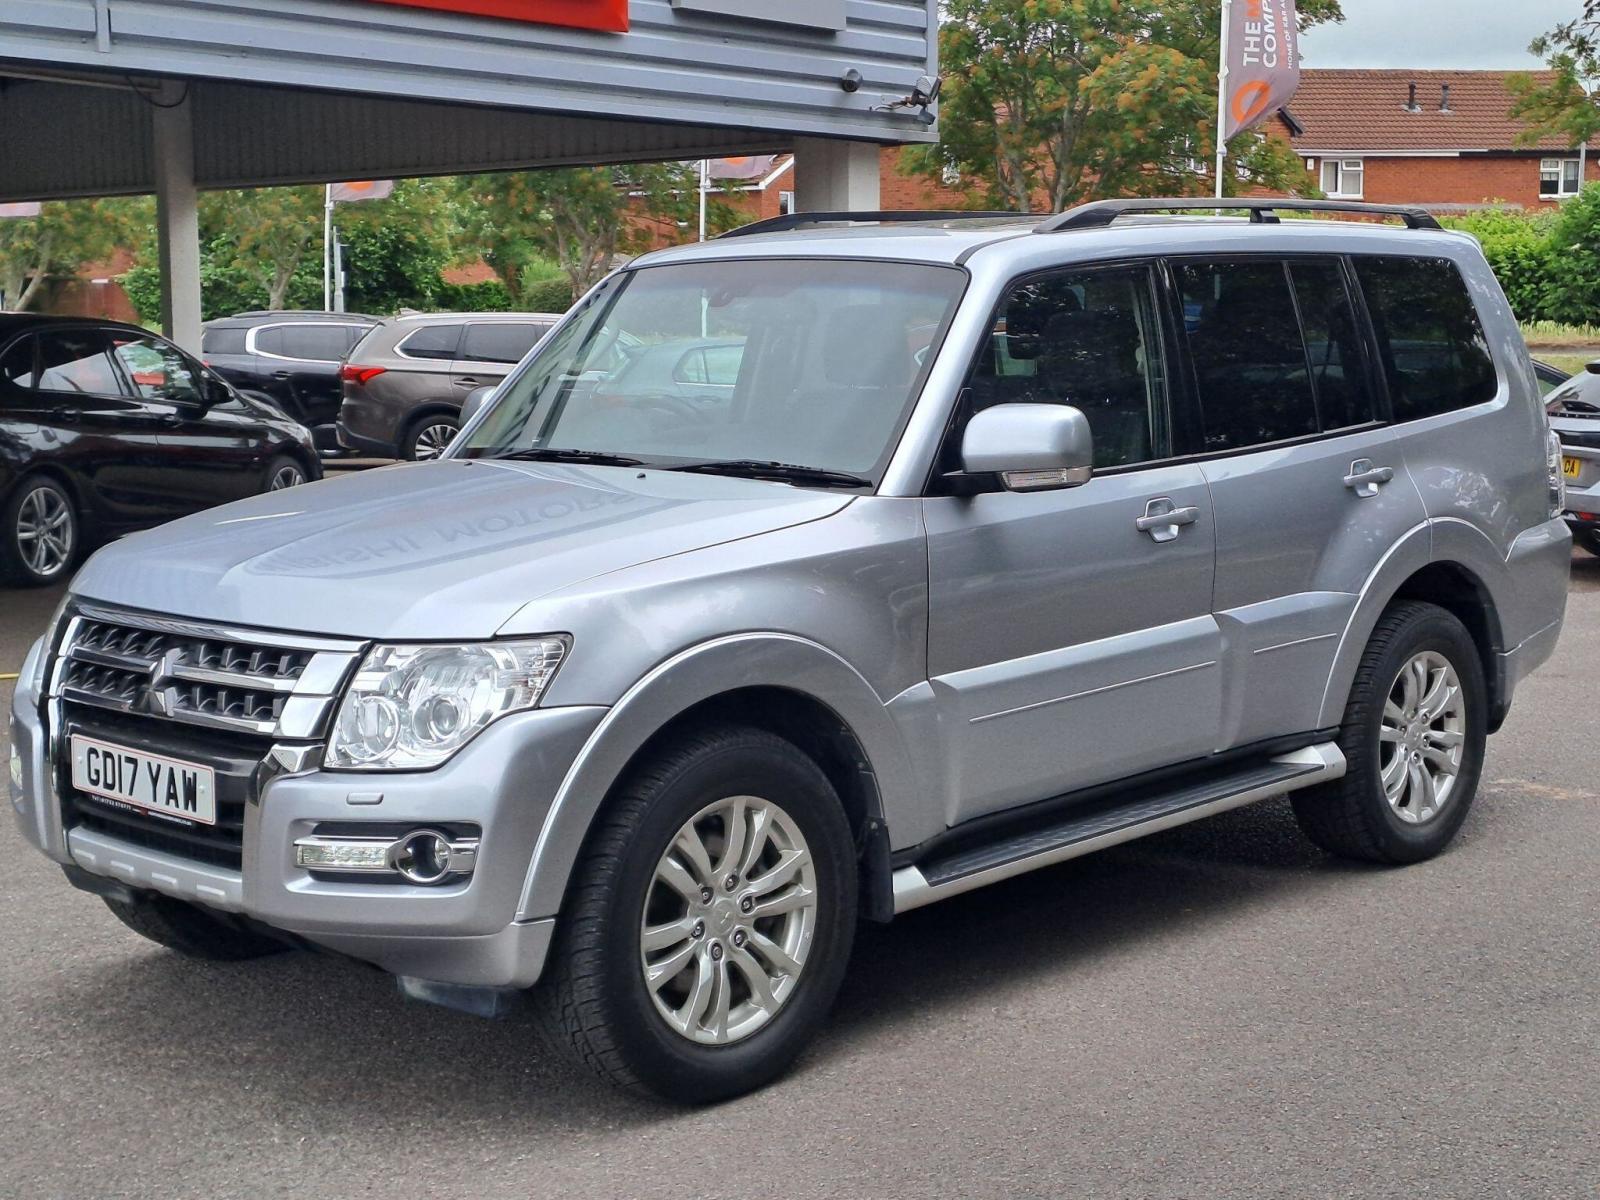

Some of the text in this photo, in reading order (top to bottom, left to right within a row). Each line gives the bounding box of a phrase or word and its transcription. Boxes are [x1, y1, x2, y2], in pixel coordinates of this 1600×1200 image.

[1243, 22, 1261, 67] THE
[1262, 0, 1277, 68] COMP
[86, 747, 197, 812] GD17 YAW
